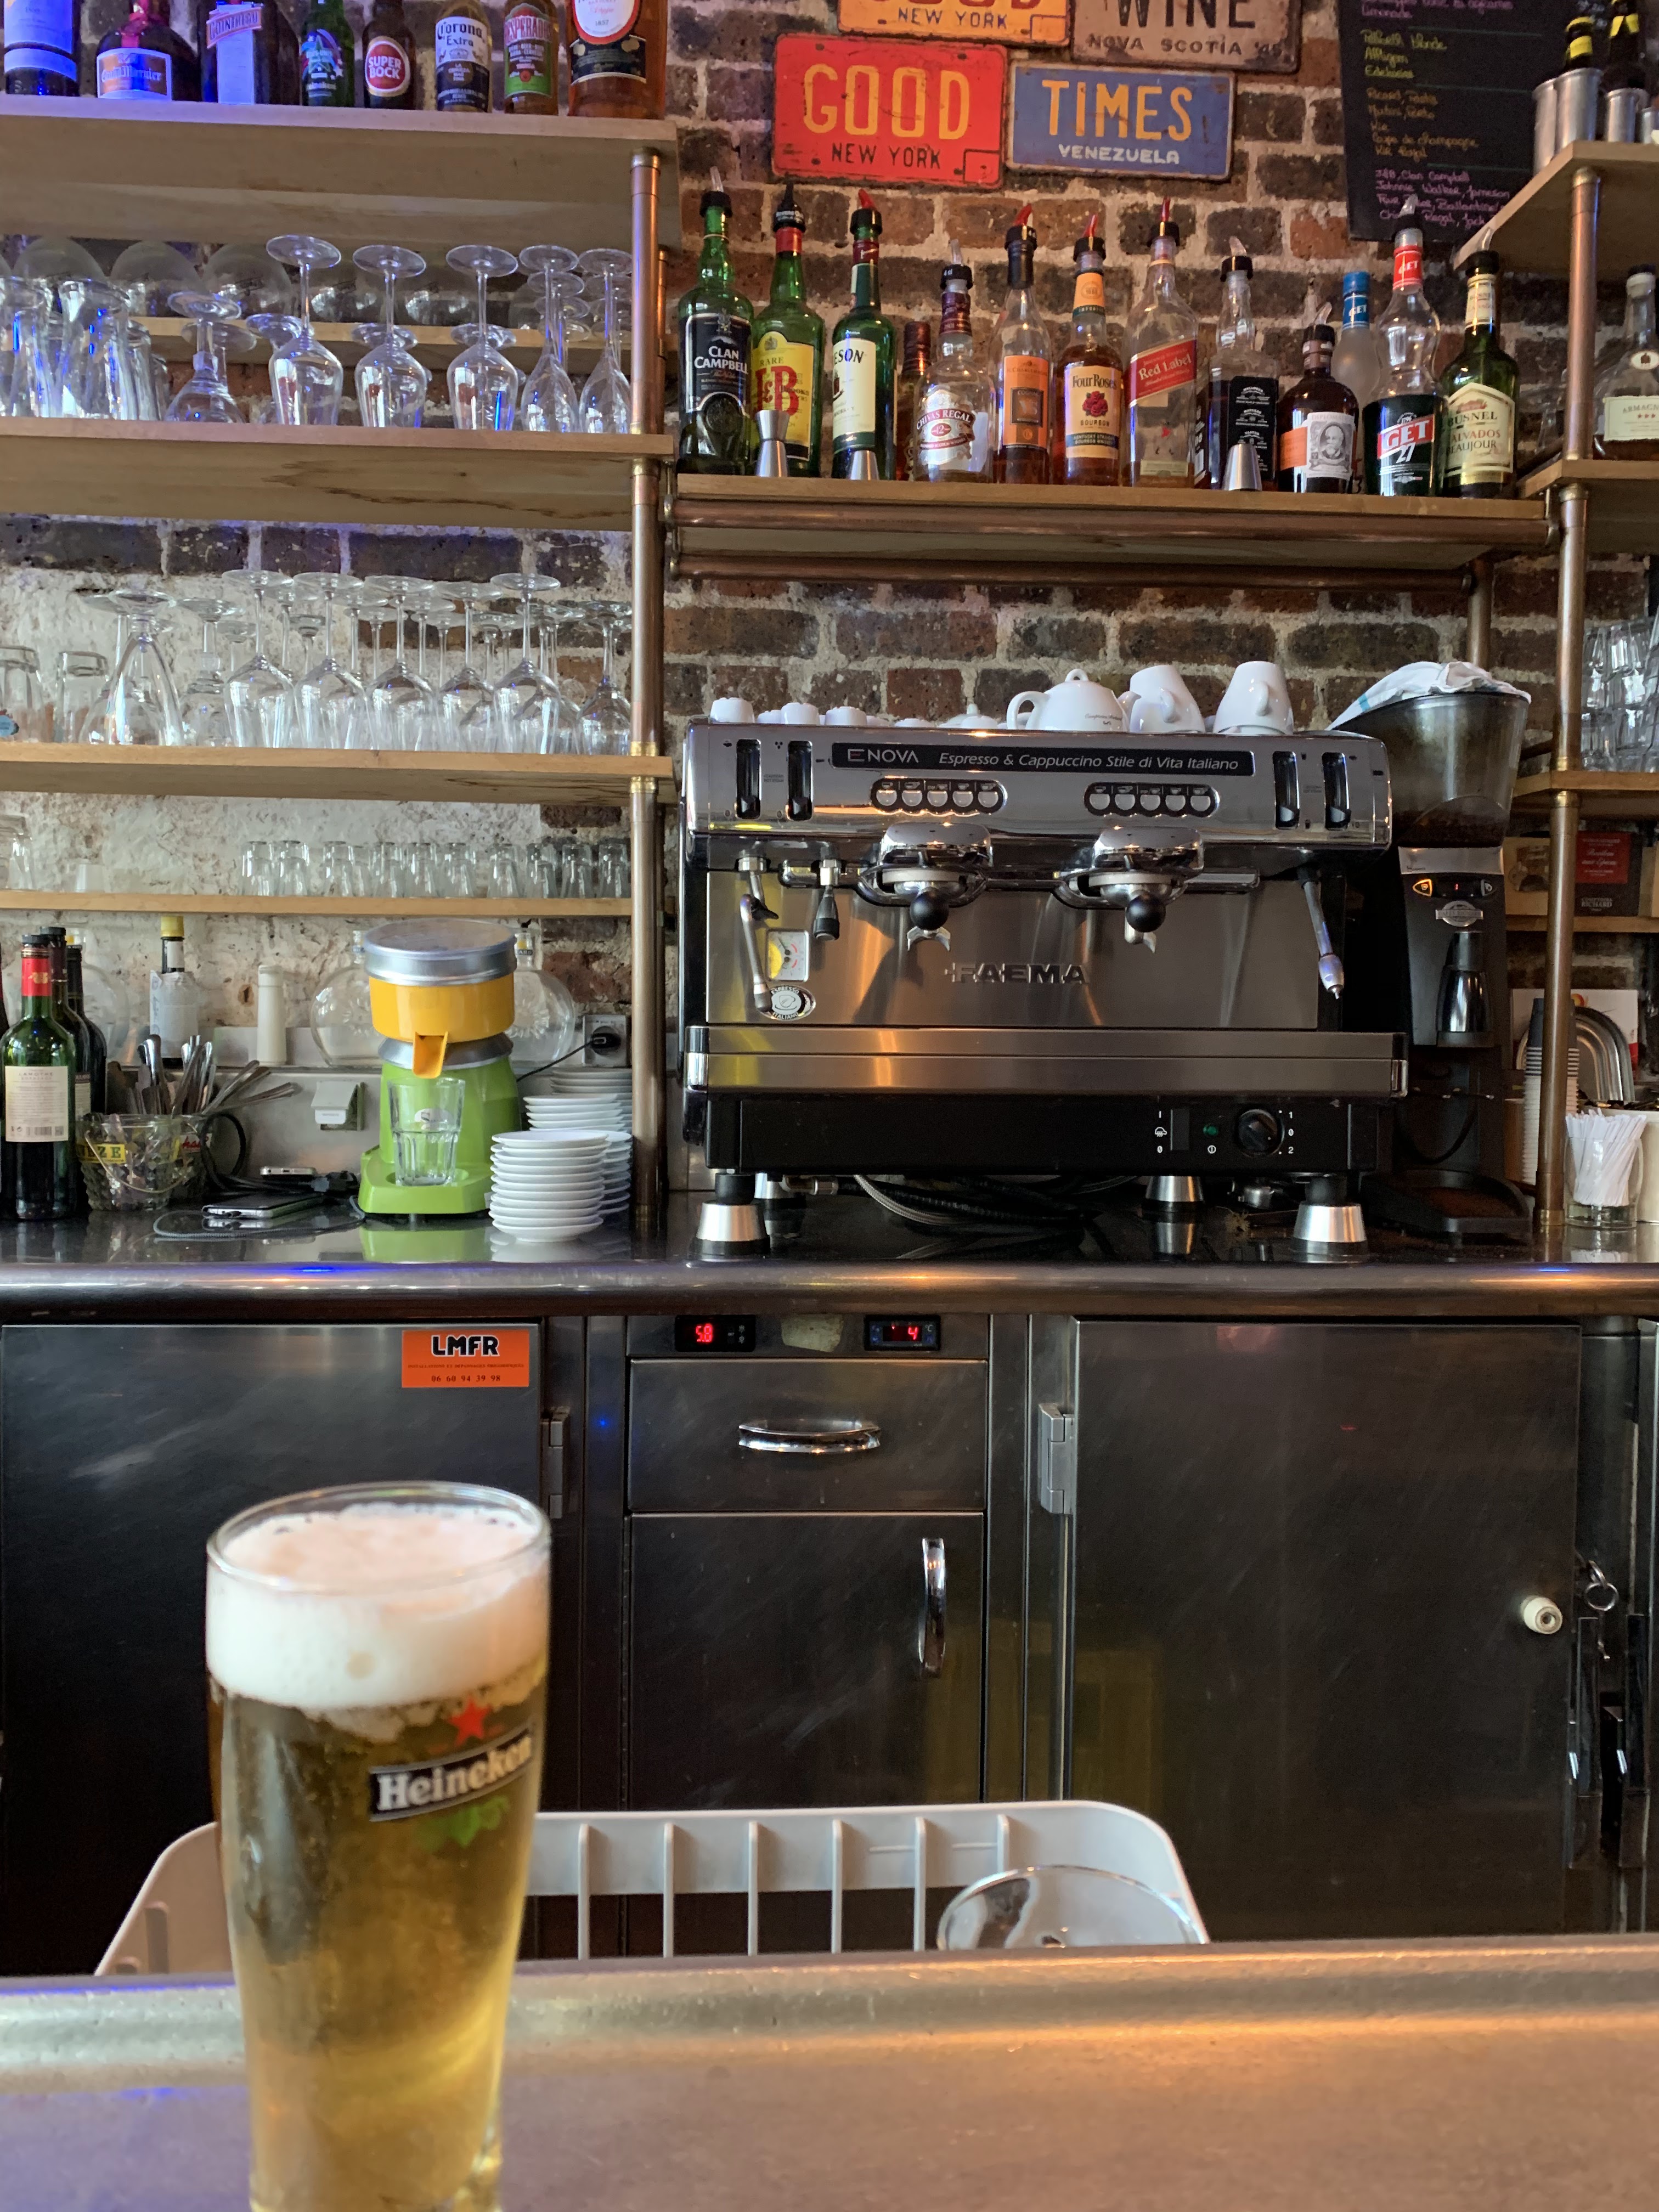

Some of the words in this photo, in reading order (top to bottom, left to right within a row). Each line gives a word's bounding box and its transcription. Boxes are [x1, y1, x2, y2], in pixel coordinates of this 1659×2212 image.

[898, 7, 943, 25] NEW
[955, 11, 1008, 29] YORK
[437, 21, 485, 43] Corona
[447, 35, 473, 46] Extra
[1086, 33, 1144, 51] NOVA
[1161, 35, 1242, 55] SCOTIA
[368, 55, 401, 70] SUPER
[369, 66, 400, 80] BOCK
[803, 63, 970, 140] GOOD
[1042, 80, 1193, 141] TIMES
[832, 143, 877, 165] NEW
[888, 146, 941, 170] YORK
[1058, 144, 1180, 164] VENEZUELA
[1399, 261, 1419, 274] GET
[1348, 304, 1367, 317] GET
[708, 346, 739, 360] CLAN
[760, 357, 785, 366] RARE
[834, 348, 865, 365] ESON
[694, 356, 749, 375] CAMPBELL
[1138, 363, 1161, 381] Red
[1163, 354, 1192, 373] Label
[1073, 375, 1093, 388] Four
[1093, 374, 1117, 390] Roses
[1622, 404, 1659, 413] ARMAGN
[917, 410, 940, 430] CHIVAS
[942, 409, 970, 423] REGAL
[1448, 411, 1498, 427] BUSNEL
[1382, 420, 1430, 450] GET
[1396, 442, 1416, 463] 27
[847, 748, 918, 763] ENOVA
[939, 752, 998, 766] Espresso
[1003, 754, 1013, 765] &
[1019, 754, 1102, 769] Cappuccino
[1106, 755, 1134, 768] Stile
[1139, 756, 1152, 768] di
[1157, 757, 1183, 768] Vita
[1188, 758, 1239, 770] Italiano
[946, 962, 1087, 983] FAEMA
[771, 986, 800, 995] ESPRESSO
[772, 1011, 799, 1020] ITALIANO
[908, 1327, 918, 1340] 4
[431, 1335, 500, 1357] LMFR
